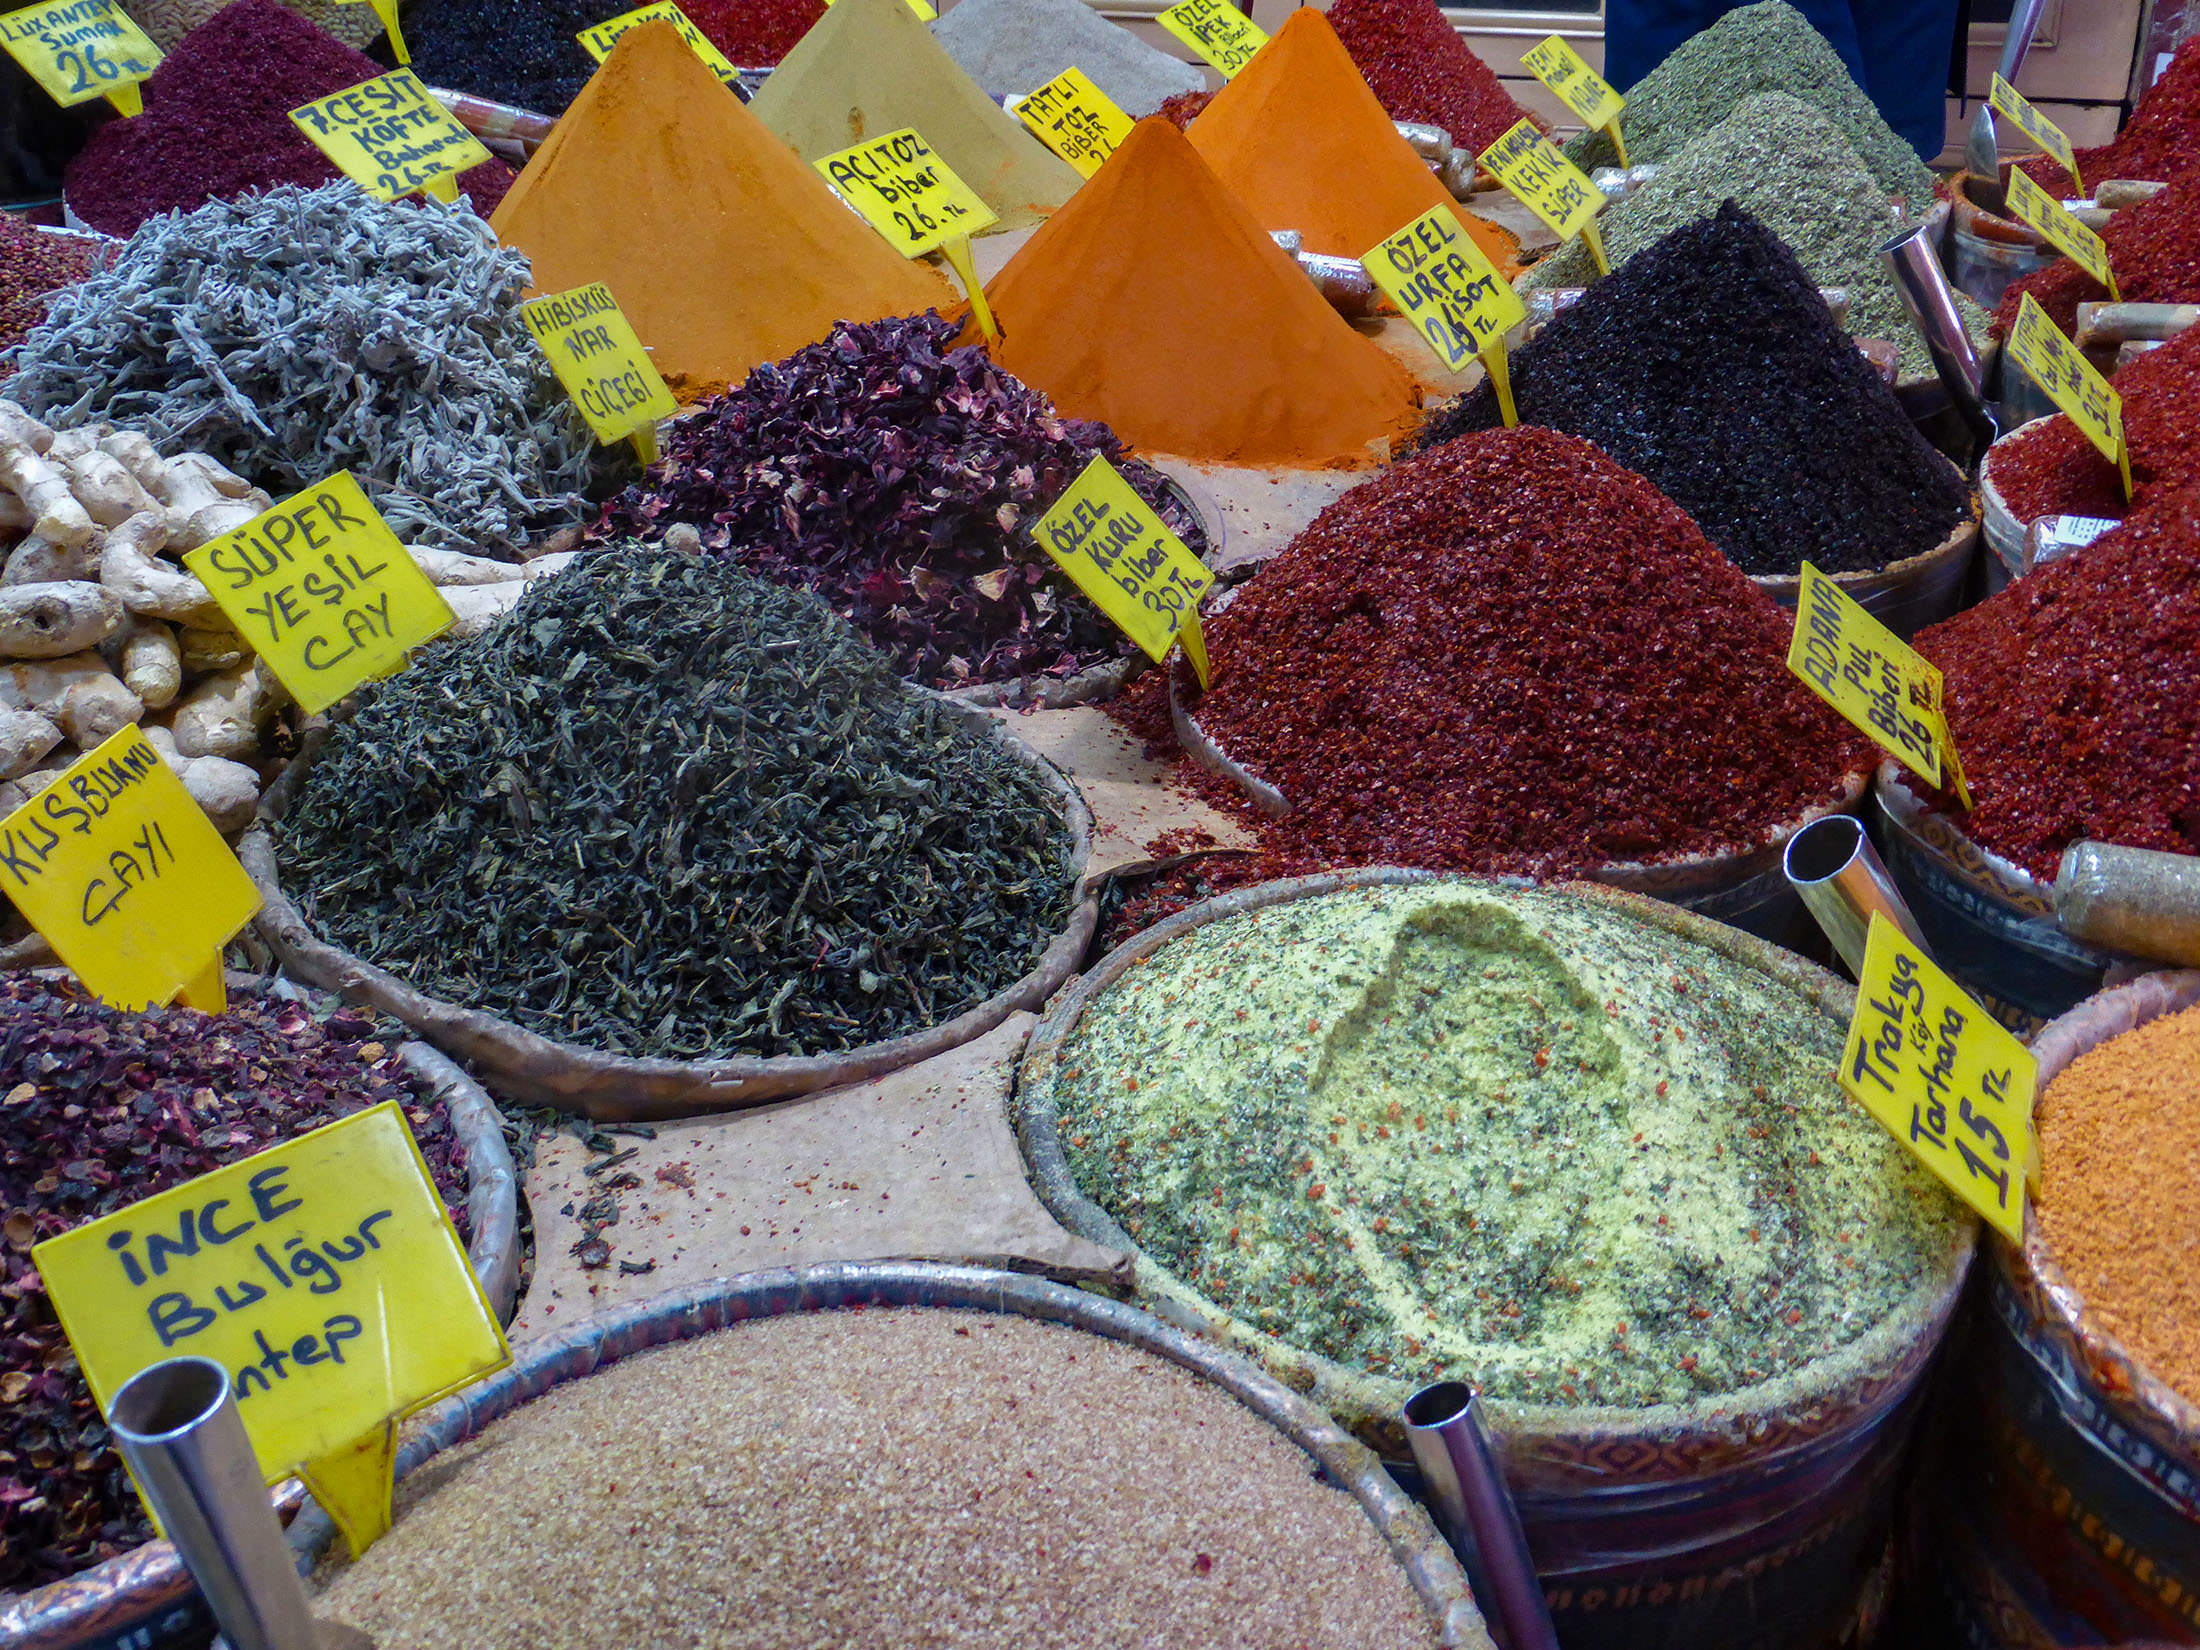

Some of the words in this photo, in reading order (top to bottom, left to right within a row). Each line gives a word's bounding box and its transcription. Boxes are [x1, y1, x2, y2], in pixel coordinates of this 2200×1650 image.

[40, 20, 126, 50] SUMAK
[1171, 0, 1222, 26] ÖZEL
[1189, 15, 1232, 46] İPEK
[57, 45, 119, 94] 26
[351, 104, 440, 154] KÖFTE
[1019, 77, 1079, 125] TATLI
[1052, 106, 1099, 137] TOZ
[1060, 121, 1110, 159] BİBER
[870, 166, 940, 204] biber
[1509, 147, 1566, 198] KEKİK
[1542, 178, 1590, 226] SÜPER
[1382, 217, 1457, 274] ÖZEL
[1398, 253, 1473, 311] URFA
[1445, 274, 1499, 319] İSOT
[528, 285, 617, 337] HİBİSKÜS
[1425, 302, 1479, 364] 26
[1473, 315, 1498, 335] TL
[564, 325, 618, 363] NAR
[210, 493, 367, 589] SÜPER
[1047, 498, 1111, 554] ÖZEL
[1084, 512, 1144, 575] KURU
[1111, 539, 1169, 599] biber
[246, 553, 388, 643] YEŞİL
[1804, 577, 1844, 697] ADANA
[1898, 710, 1935, 771] 26
[82, 820, 176, 927] ÇAYI
[1852, 953, 1925, 1094] Trakya
[1910, 1006, 1969, 1151] Tarhana
[1954, 1096, 2010, 1211] 15
[1982, 1068, 2012, 1104] TL
[106, 1165, 303, 1287] İNCE
[147, 1209, 393, 1349] Bulğur
